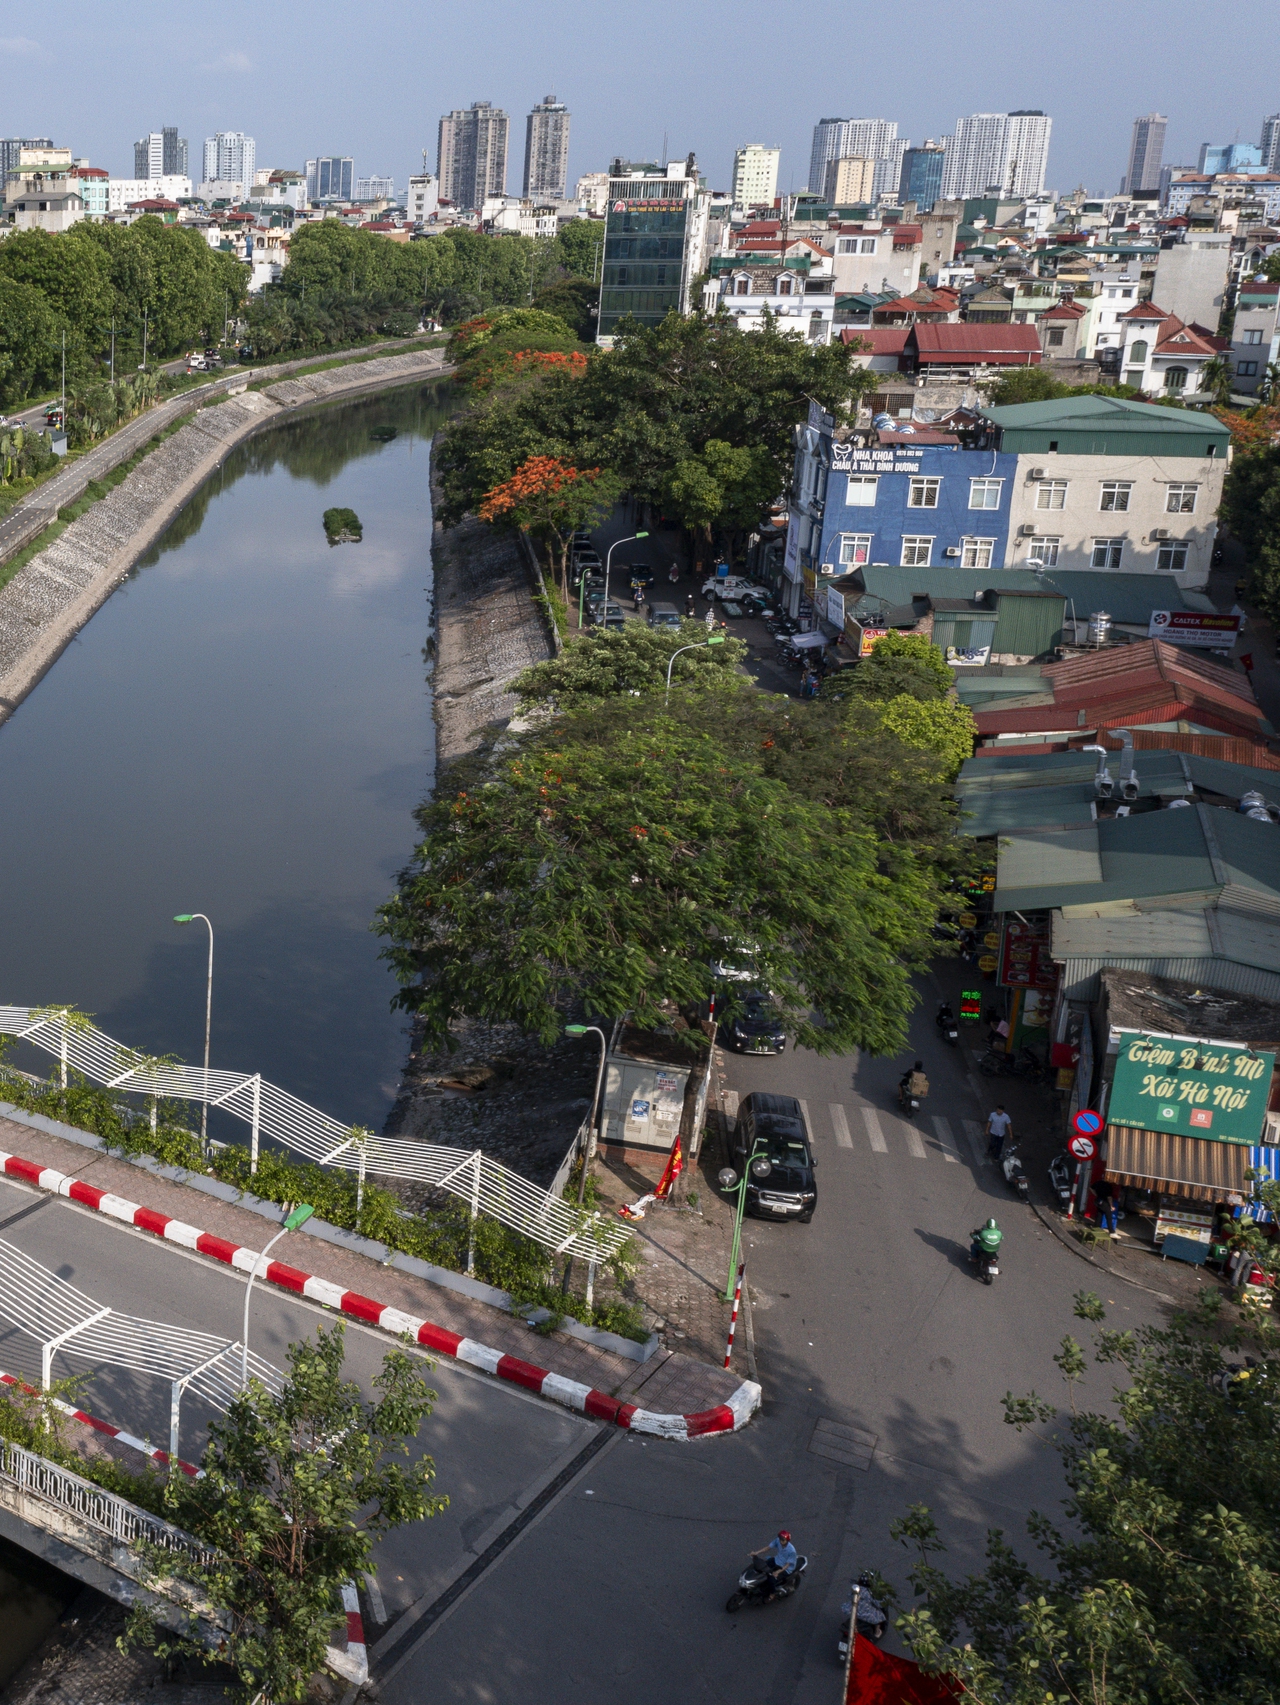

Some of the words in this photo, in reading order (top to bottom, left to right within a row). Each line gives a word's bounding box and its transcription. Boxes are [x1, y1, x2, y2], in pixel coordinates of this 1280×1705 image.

[872, 451, 893, 461] KHOA
[860, 459, 874, 470] THÁI
[1202, 618, 1235, 626] Havoline
[958, 647, 986, 660] Tiger
[1128, 1040, 1175, 1067] Tiệm
[1139, 1074, 1178, 1098] Xôi
[1178, 1080, 1210, 1104] Hà
[1213, 1085, 1250, 1112] Nội
